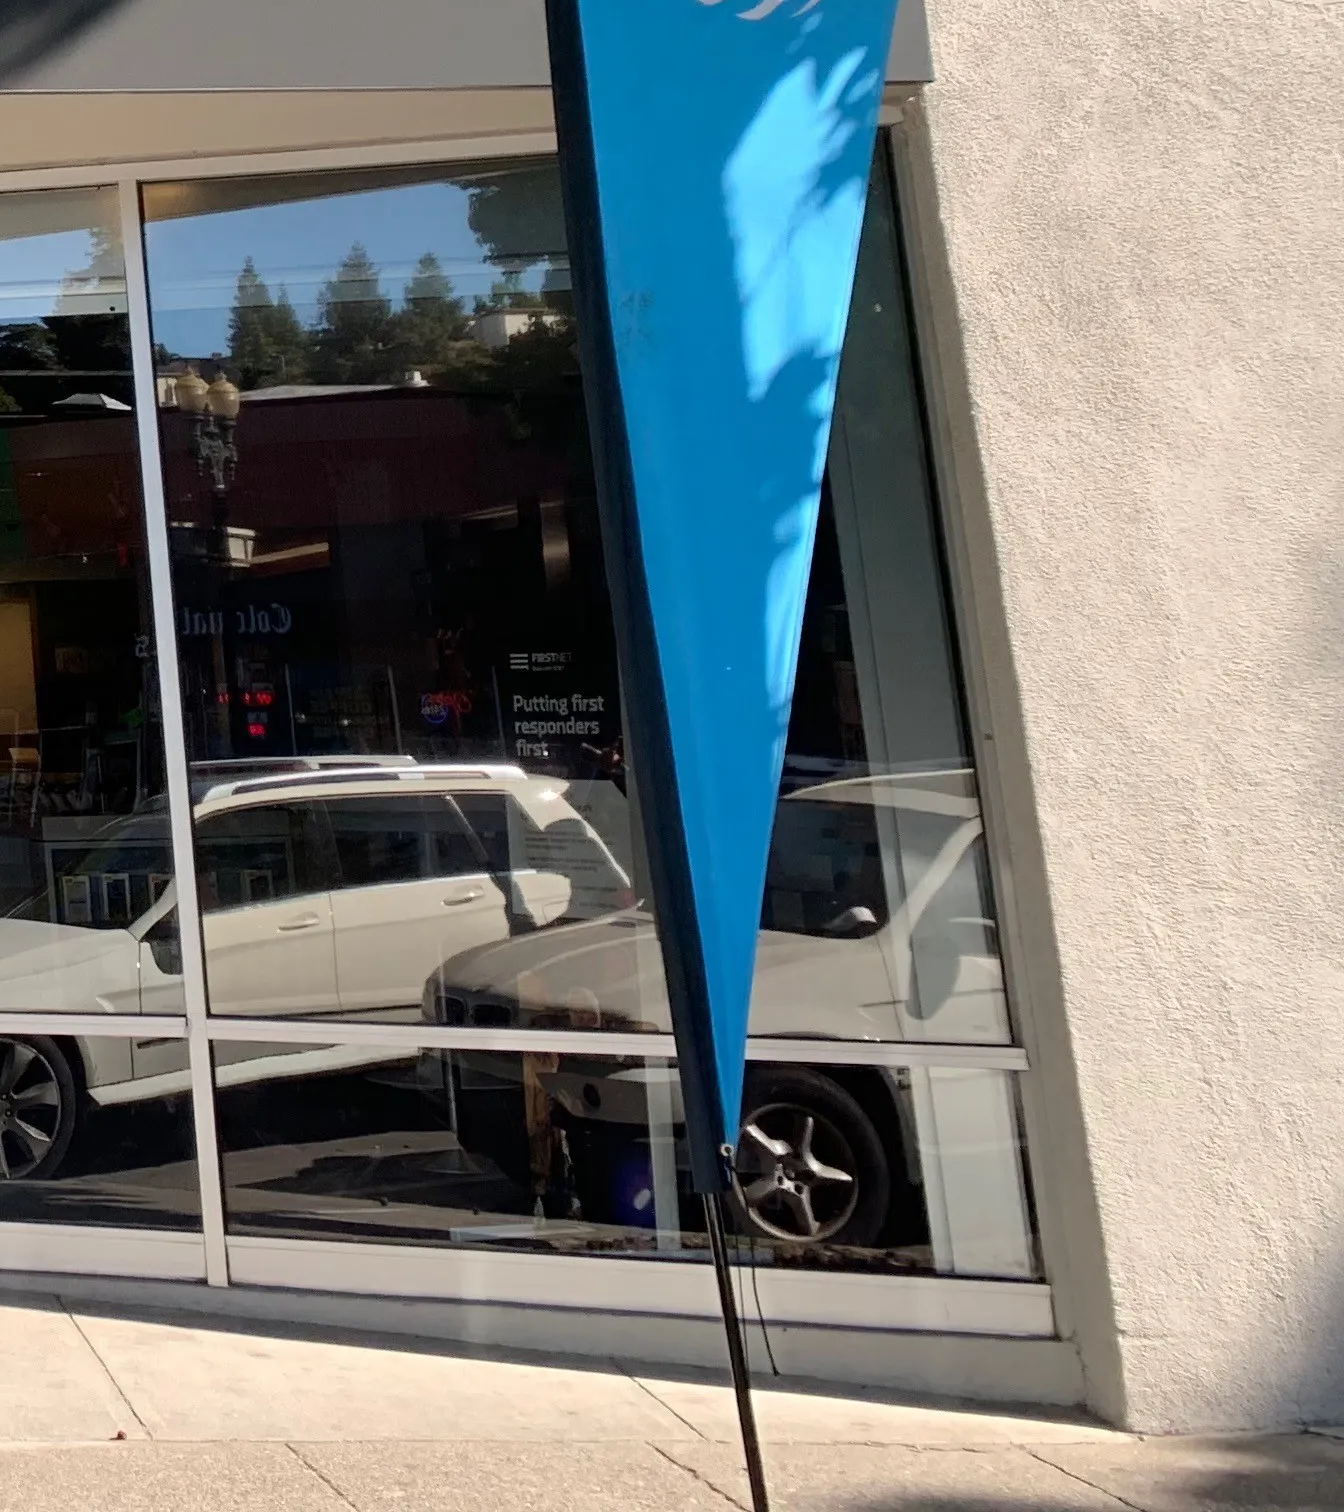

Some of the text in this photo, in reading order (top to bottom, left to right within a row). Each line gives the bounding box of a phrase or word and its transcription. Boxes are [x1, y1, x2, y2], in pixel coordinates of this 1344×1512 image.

[513, 694, 604, 715] Putting first
[515, 716, 600, 737] responders
